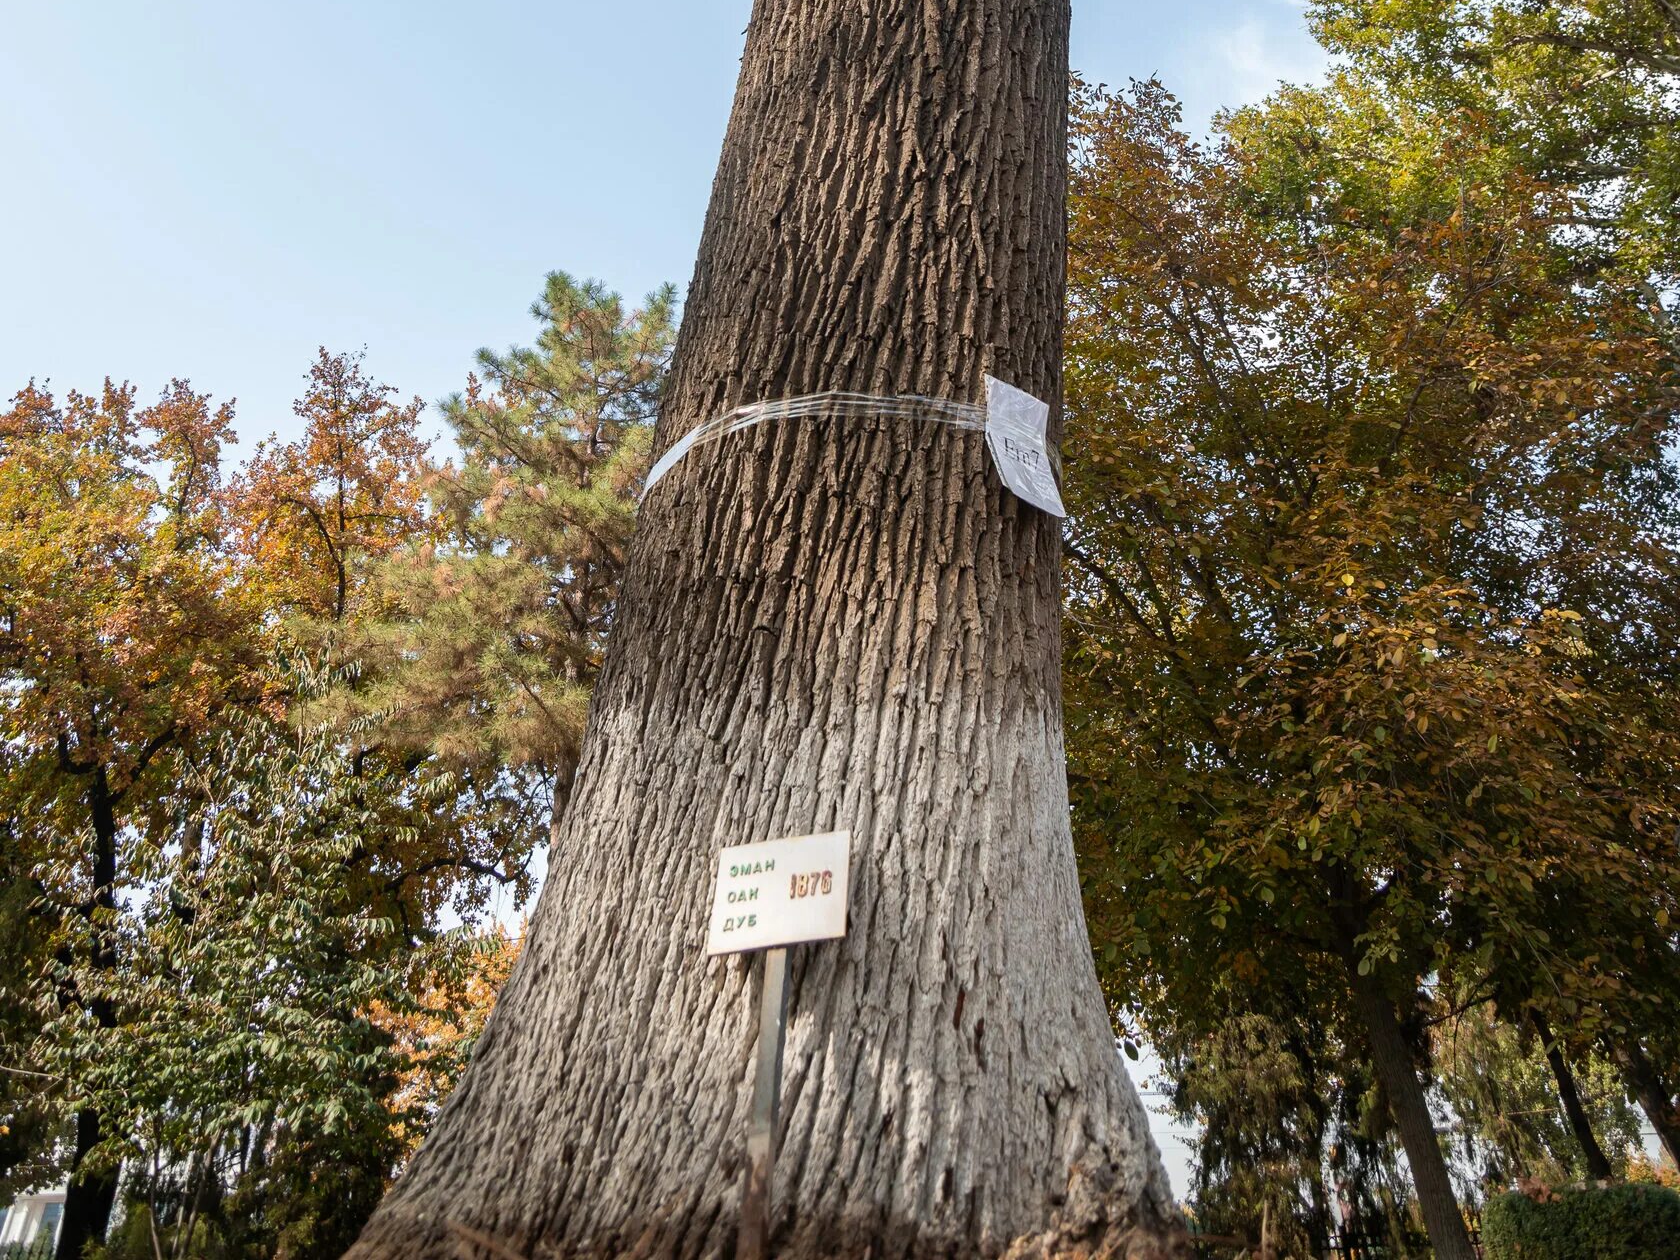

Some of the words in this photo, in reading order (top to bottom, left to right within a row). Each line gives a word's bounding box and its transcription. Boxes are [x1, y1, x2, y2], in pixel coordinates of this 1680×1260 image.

[729, 858, 776, 877] ЭМАН
[790, 870, 833, 900] 1876
[727, 887, 759, 904] ОАН
[723, 914, 757, 932] ДУБ
